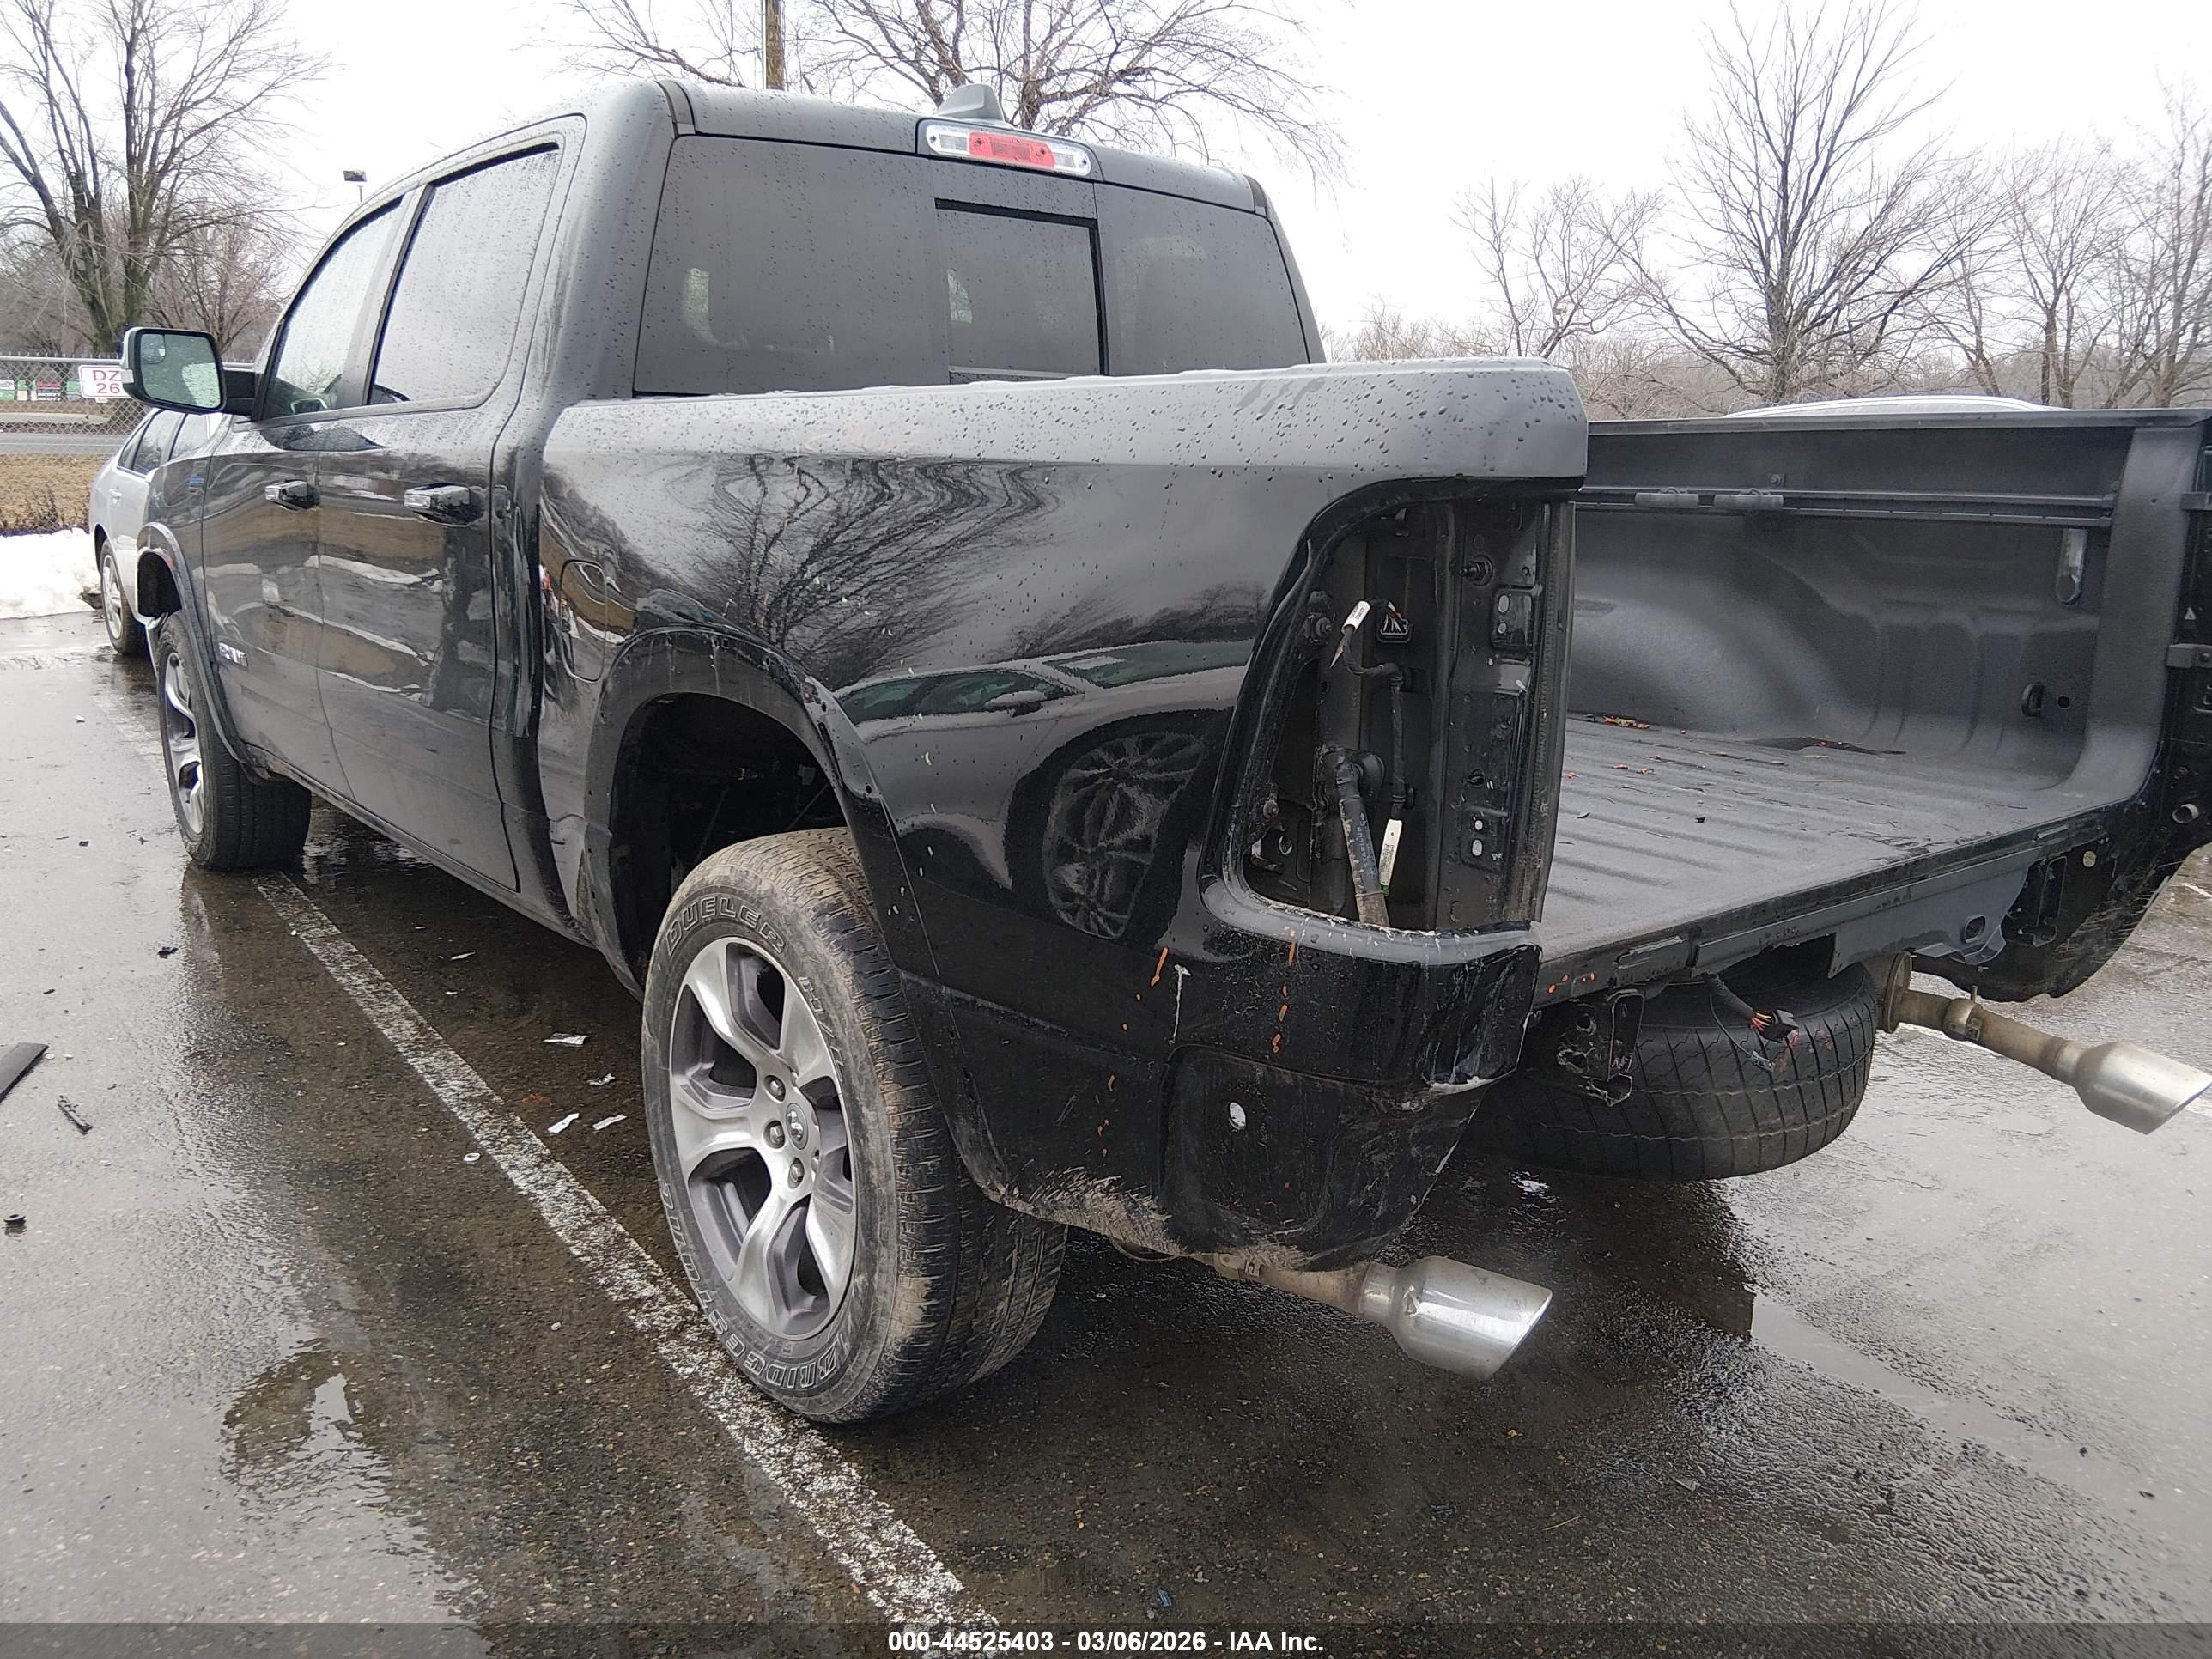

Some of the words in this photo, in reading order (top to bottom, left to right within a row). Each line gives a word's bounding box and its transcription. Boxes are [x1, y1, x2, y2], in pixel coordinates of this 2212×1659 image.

[96, 383, 120, 394] 26
[664, 895, 787, 957] DUELER
[659, 1180, 838, 1389] BRIDGESTONE
